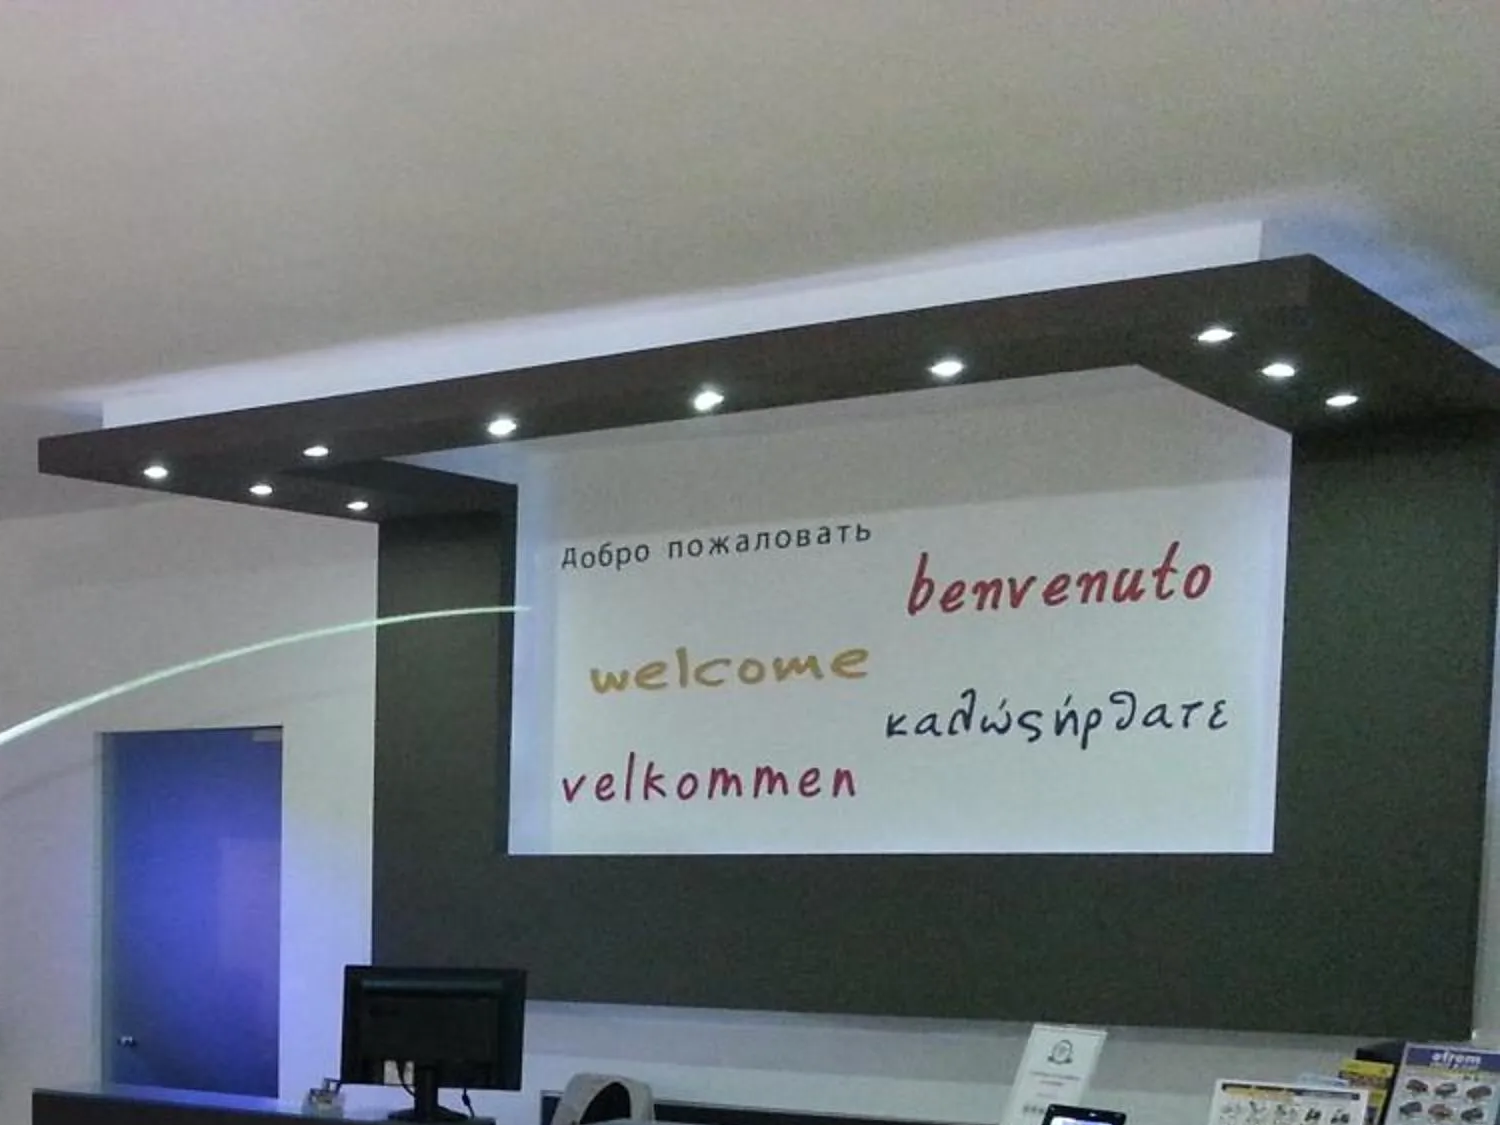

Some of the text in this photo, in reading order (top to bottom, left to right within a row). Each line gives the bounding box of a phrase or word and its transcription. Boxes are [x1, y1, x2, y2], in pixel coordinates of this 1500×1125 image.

[561, 523, 872, 572] Добро пожаловать
[906, 540, 1213, 617] benvenuto
[589, 646, 870, 694] welcome
[561, 751, 857, 803] velkommen
